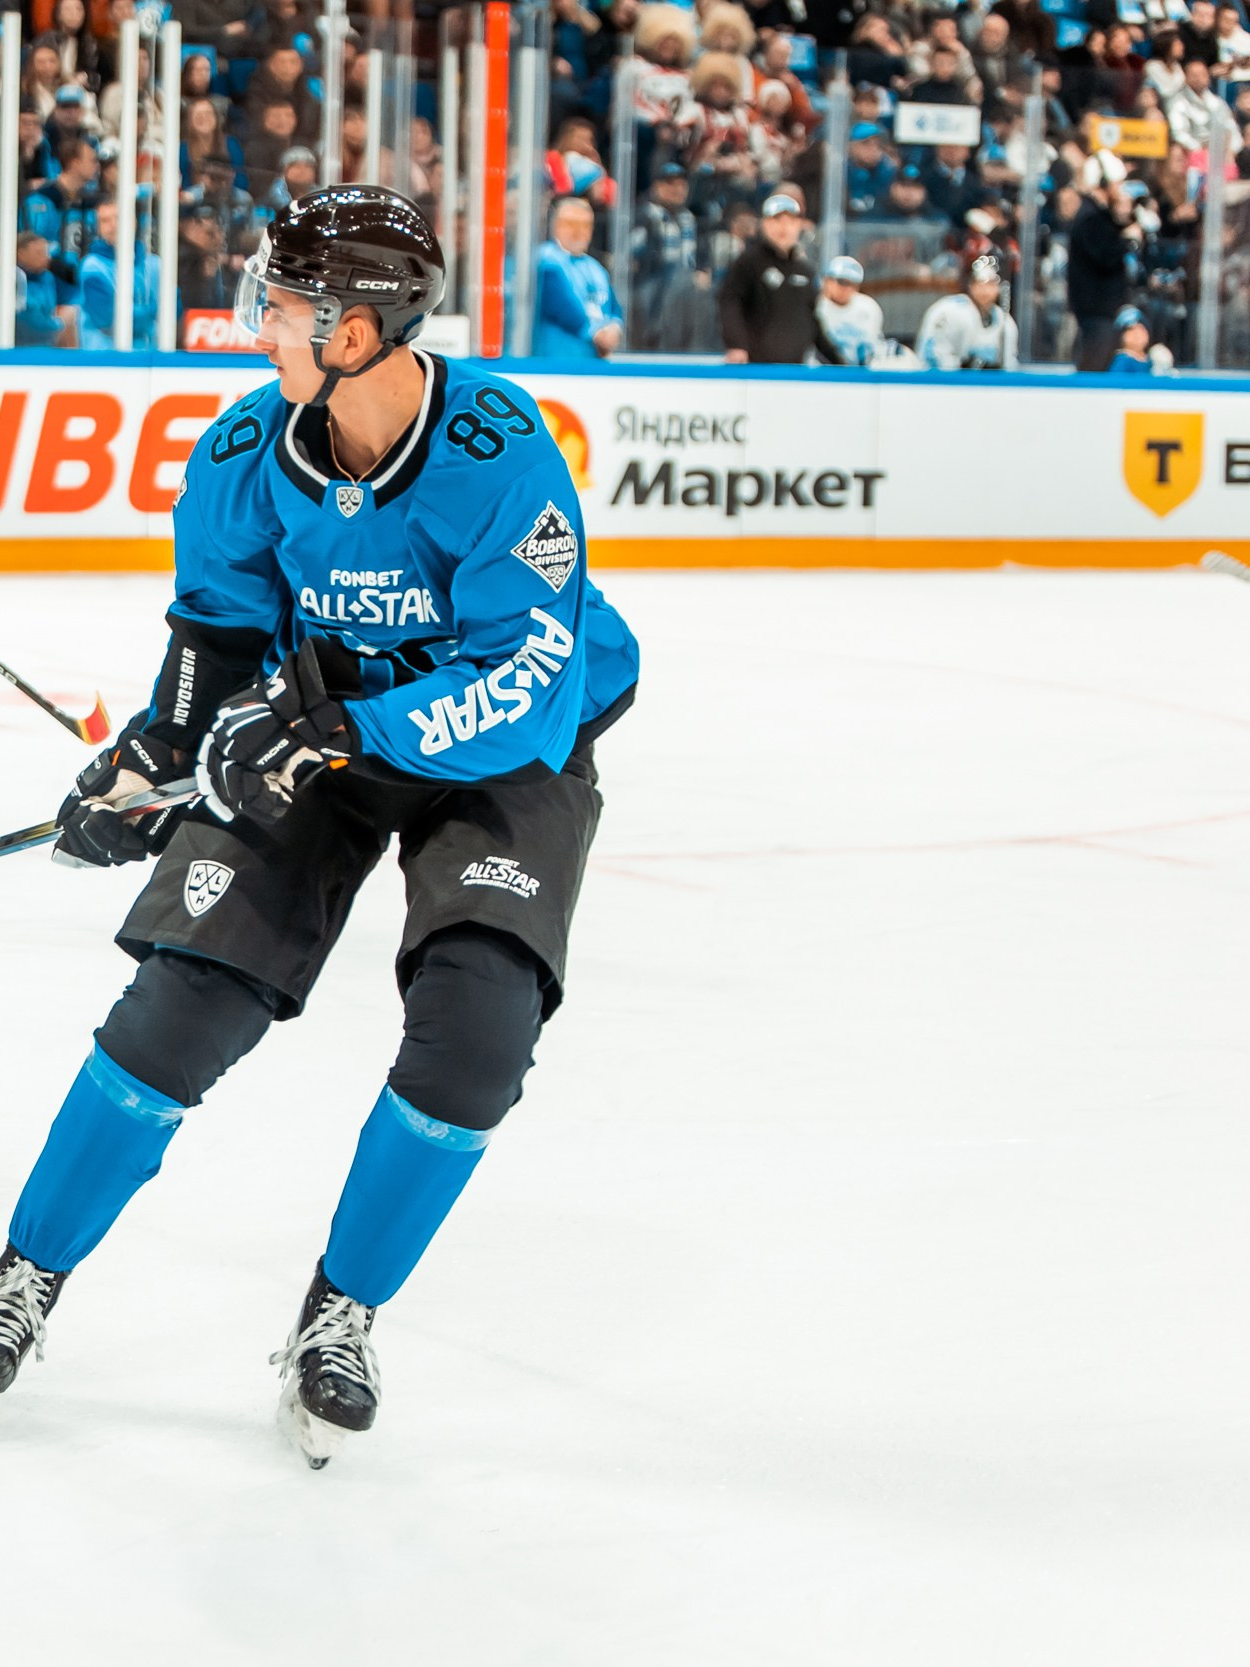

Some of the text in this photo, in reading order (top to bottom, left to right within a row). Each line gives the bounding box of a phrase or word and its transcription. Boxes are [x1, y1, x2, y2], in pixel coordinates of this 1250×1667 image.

[355, 279, 400, 291] CCM
[445, 386, 537, 463] 89
[613, 405, 747, 447] Яндекс
[611, 458, 886, 518] Маркет
[526, 535, 575, 557] BOBROV
[534, 551, 575, 566] DIVISION
[330, 569, 403, 588] FONBET
[172, 646, 197, 726] NOVOSIBIR
[130, 739, 159, 772] CCM
[256, 738, 290, 766] TACKS
[485, 855, 521, 868] FONBET
